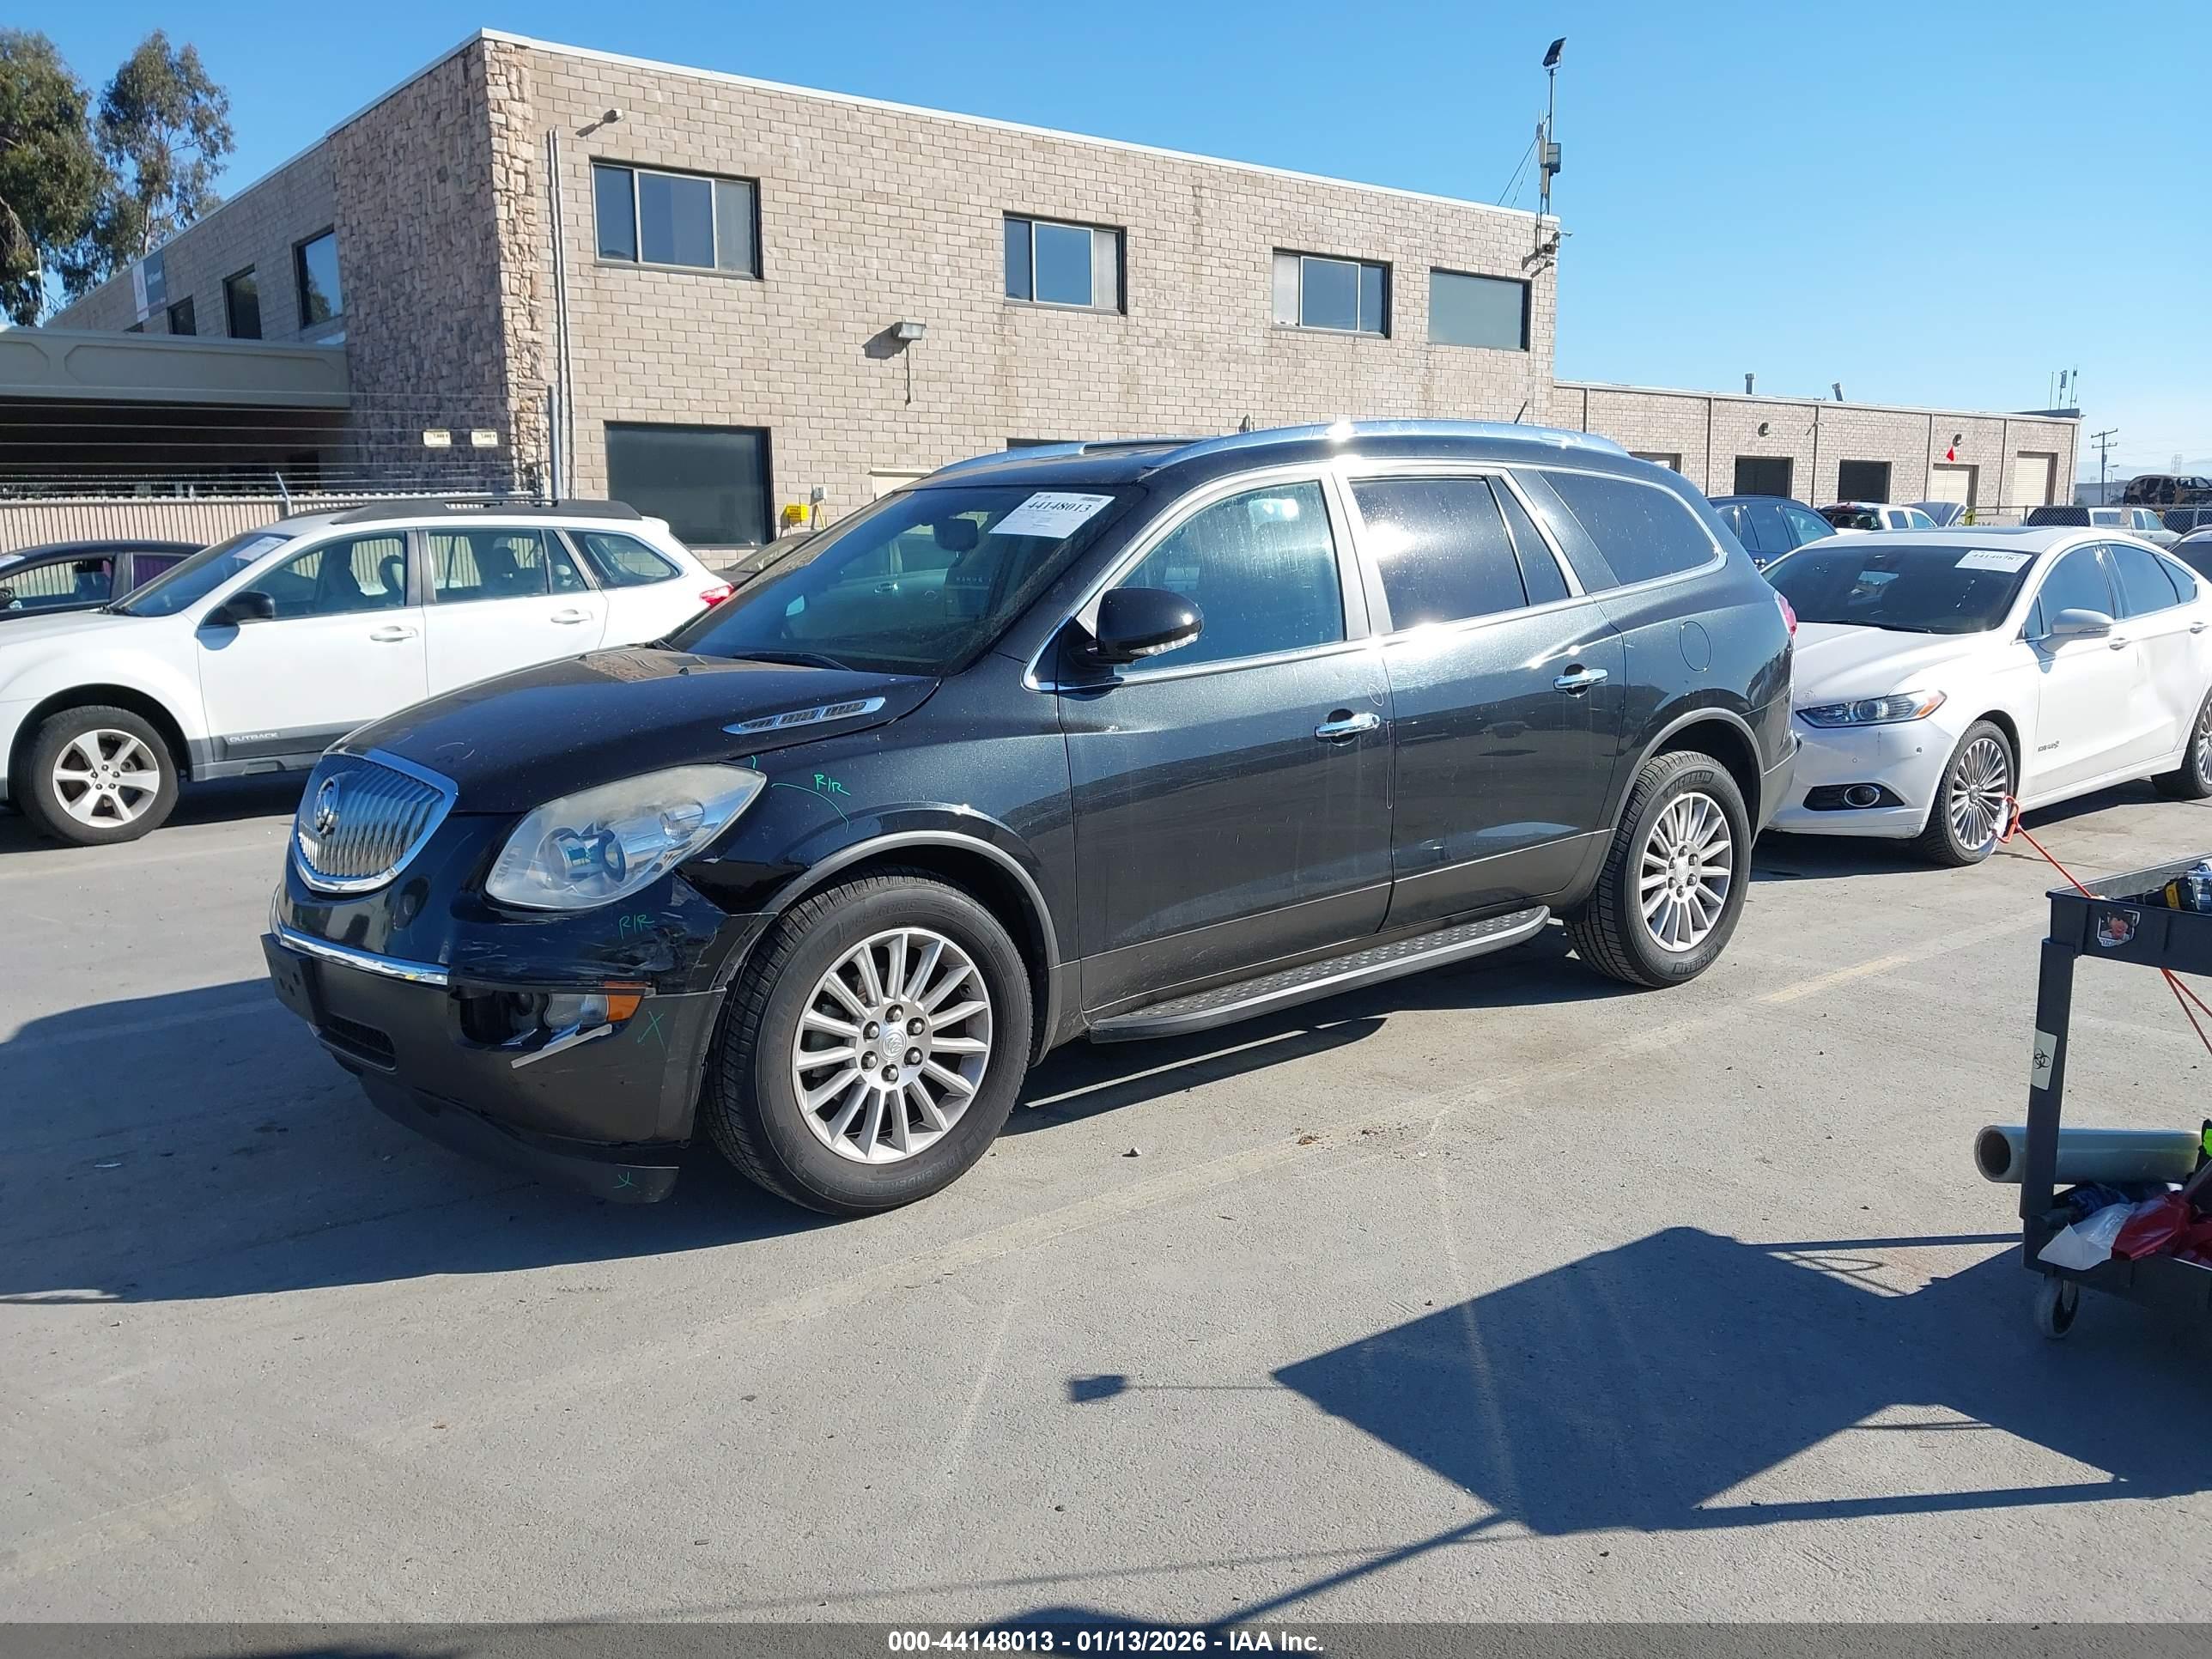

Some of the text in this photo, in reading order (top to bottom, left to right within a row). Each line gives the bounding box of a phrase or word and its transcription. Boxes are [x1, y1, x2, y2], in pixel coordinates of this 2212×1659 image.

[1028, 501, 1092, 513] 44148013
[228, 732, 278, 743] OUTBACK
[1666, 771, 1715, 799] MICHELIN
